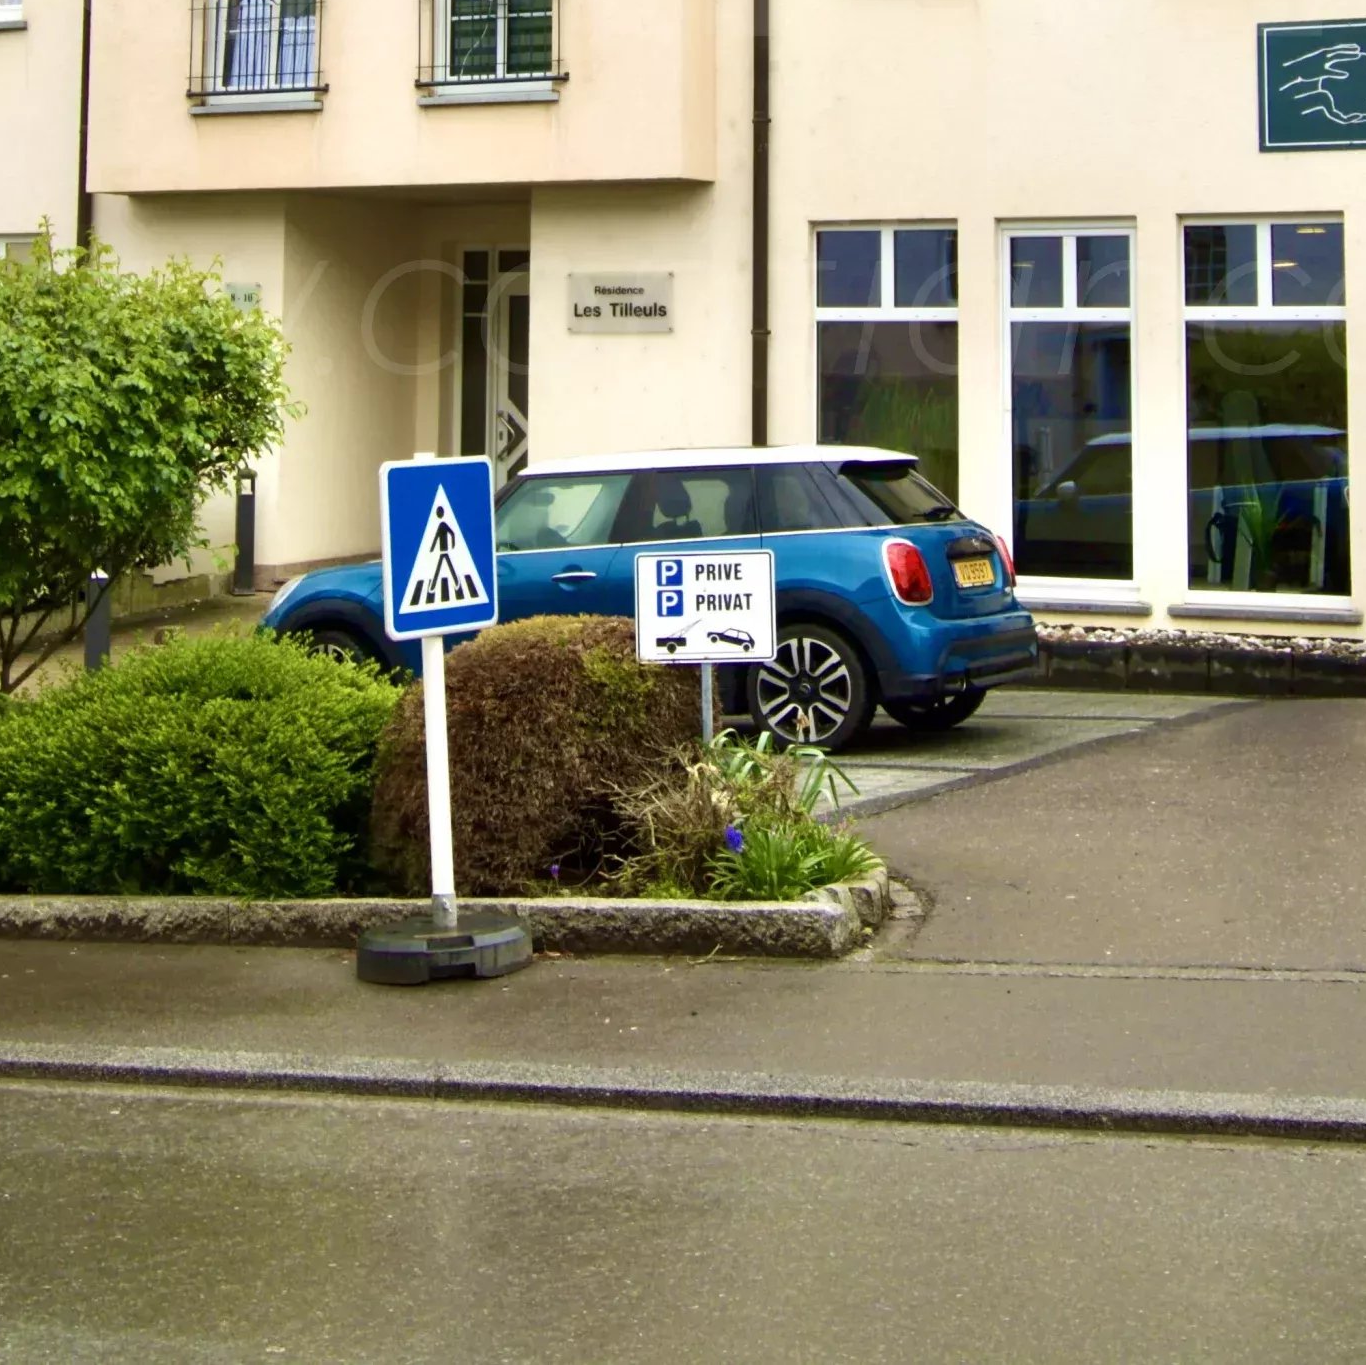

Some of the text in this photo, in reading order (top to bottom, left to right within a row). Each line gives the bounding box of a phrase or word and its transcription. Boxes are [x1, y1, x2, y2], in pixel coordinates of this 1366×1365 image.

[594, 285, 645, 295] Résidence
[574, 302, 668, 318] Les Tilleuls
[695, 563, 743, 581] PRIVE
[696, 593, 753, 612] PRIVAT
